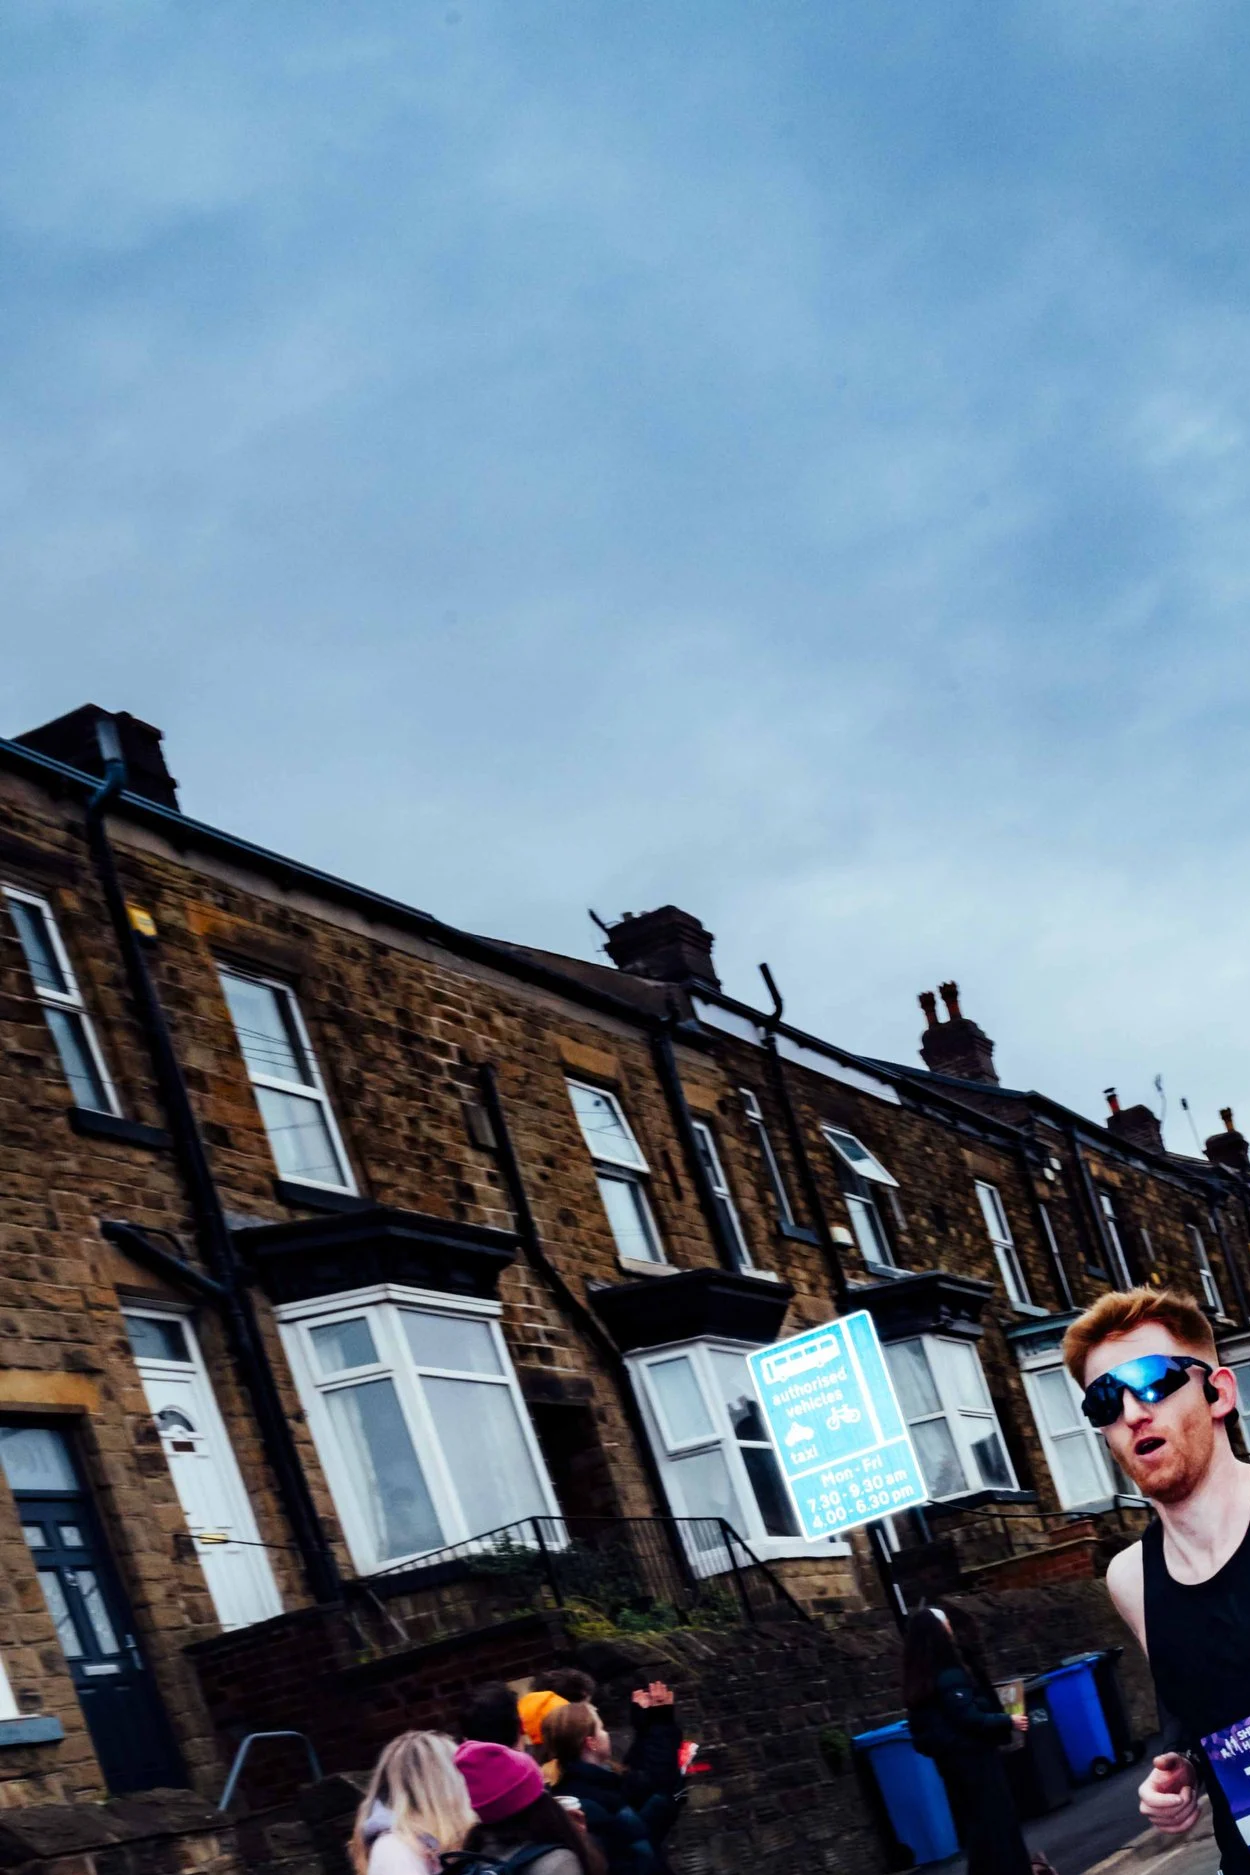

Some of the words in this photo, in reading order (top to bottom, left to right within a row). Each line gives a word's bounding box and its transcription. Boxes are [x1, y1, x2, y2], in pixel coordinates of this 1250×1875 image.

[772, 1367, 847, 1406] authorised
[785, 1388, 844, 1418] vehicles
[790, 1446, 819, 1465] taxi
[821, 1467, 853, 1488] Mon
[862, 1454, 883, 1473] Fri
[807, 1490, 840, 1513] 7.30
[850, 1475, 883, 1497] 9.30
[885, 1470, 908, 1485] am
[812, 1507, 846, 1530] 4.00
[856, 1492, 889, 1514] 6.30
[892, 1486, 914, 1504] pm
